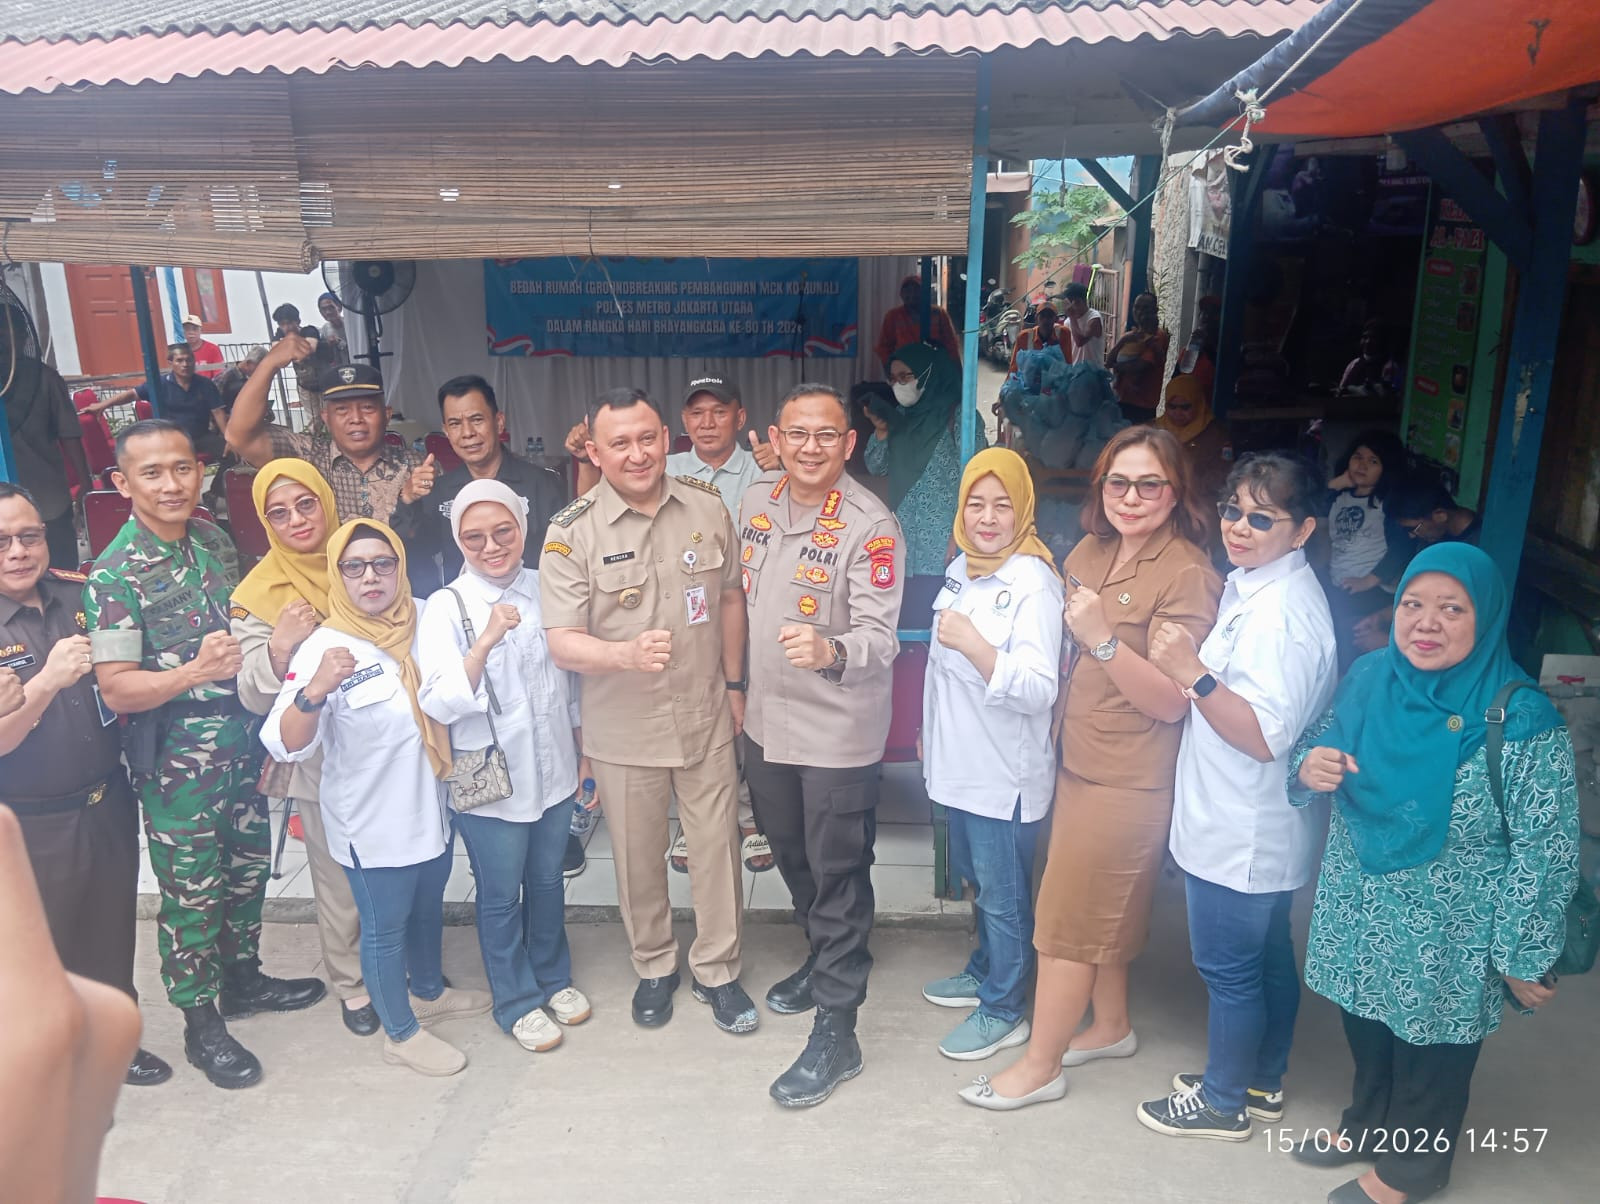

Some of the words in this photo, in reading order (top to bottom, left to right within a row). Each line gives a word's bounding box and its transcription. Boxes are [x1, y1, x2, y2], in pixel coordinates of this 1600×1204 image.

[510, 280, 543, 294] BEDAH
[546, 280, 582, 295] RUMAH
[680, 281, 756, 296] PEMBANGUNAN
[759, 281, 784, 295] MCK
[636, 300, 671, 314] METRO
[673, 301, 719, 315] JAKARTA
[721, 300, 754, 315] UTARA
[546, 319, 582, 334] DALAM
[585, 319, 625, 335] RANGKA
[627, 320, 651, 334] HARI
[654, 320, 726, 335] BHAYANGKARA
[762, 320, 775, 334] TH
[741, 526, 772, 547] ERICK
[799, 546, 839, 567] POLRI
